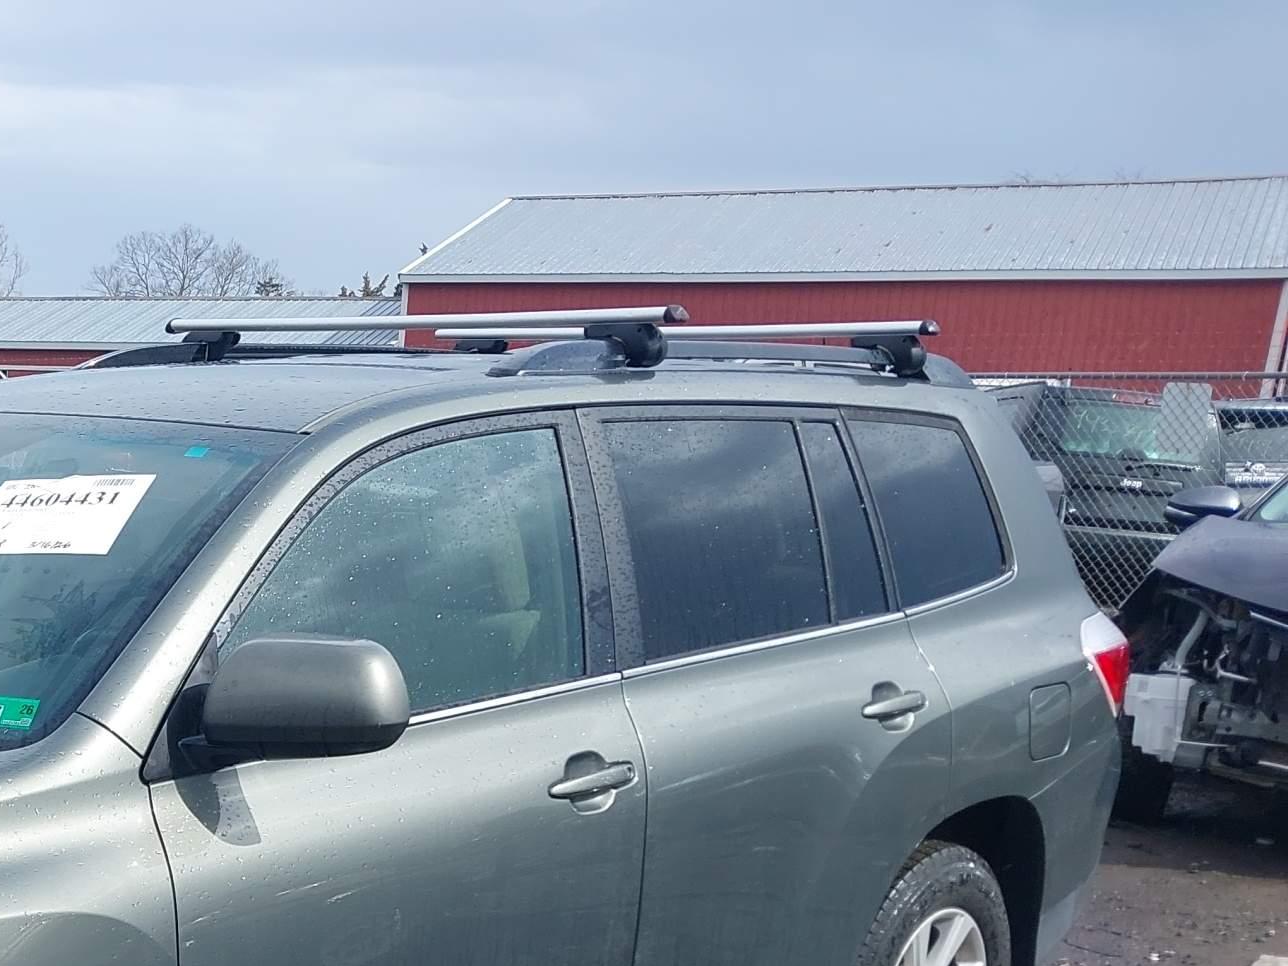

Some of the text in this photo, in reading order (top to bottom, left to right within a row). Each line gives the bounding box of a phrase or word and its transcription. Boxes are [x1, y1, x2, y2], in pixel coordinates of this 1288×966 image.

[1120, 478, 1143, 488] Jeep
[1, 491, 121, 508] 44604431
[19, 704, 35, 715] 26
